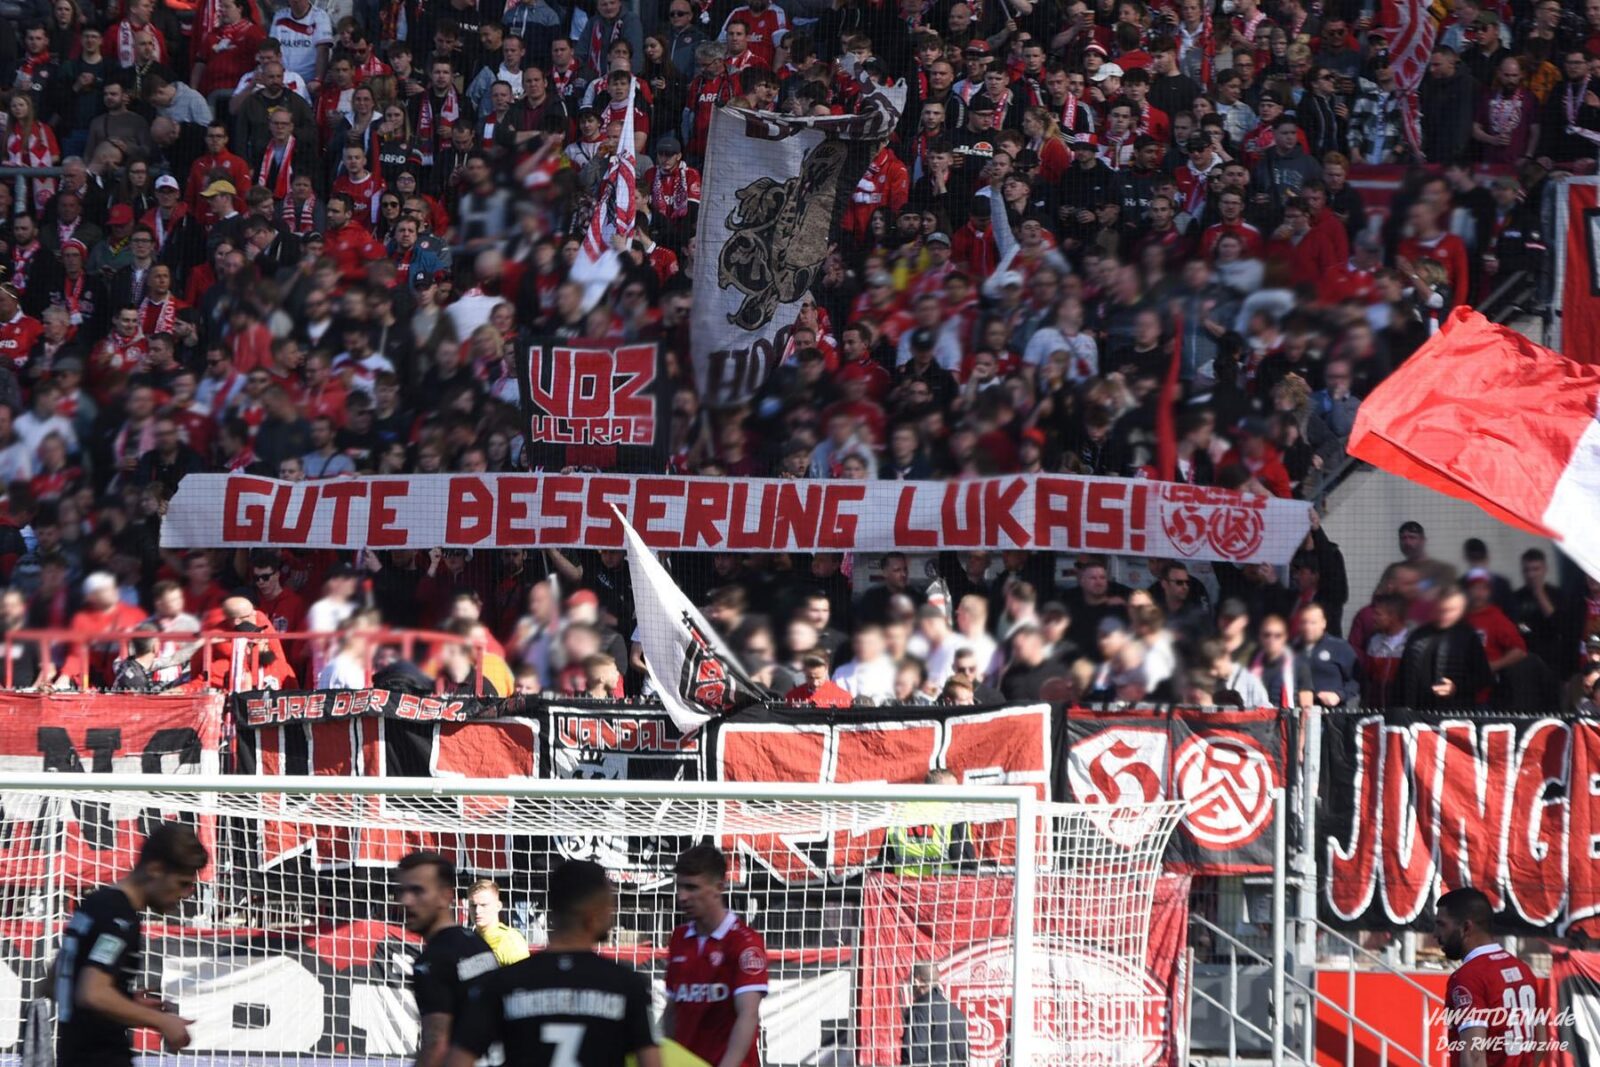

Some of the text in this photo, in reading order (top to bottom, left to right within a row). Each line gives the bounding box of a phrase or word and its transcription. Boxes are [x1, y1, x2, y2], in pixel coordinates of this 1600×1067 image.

[223, 475, 1147, 552] GUTE BESSERUNG LUKAS!
[247, 694, 326, 725] EHRE
[331, 689, 390, 716] DER
